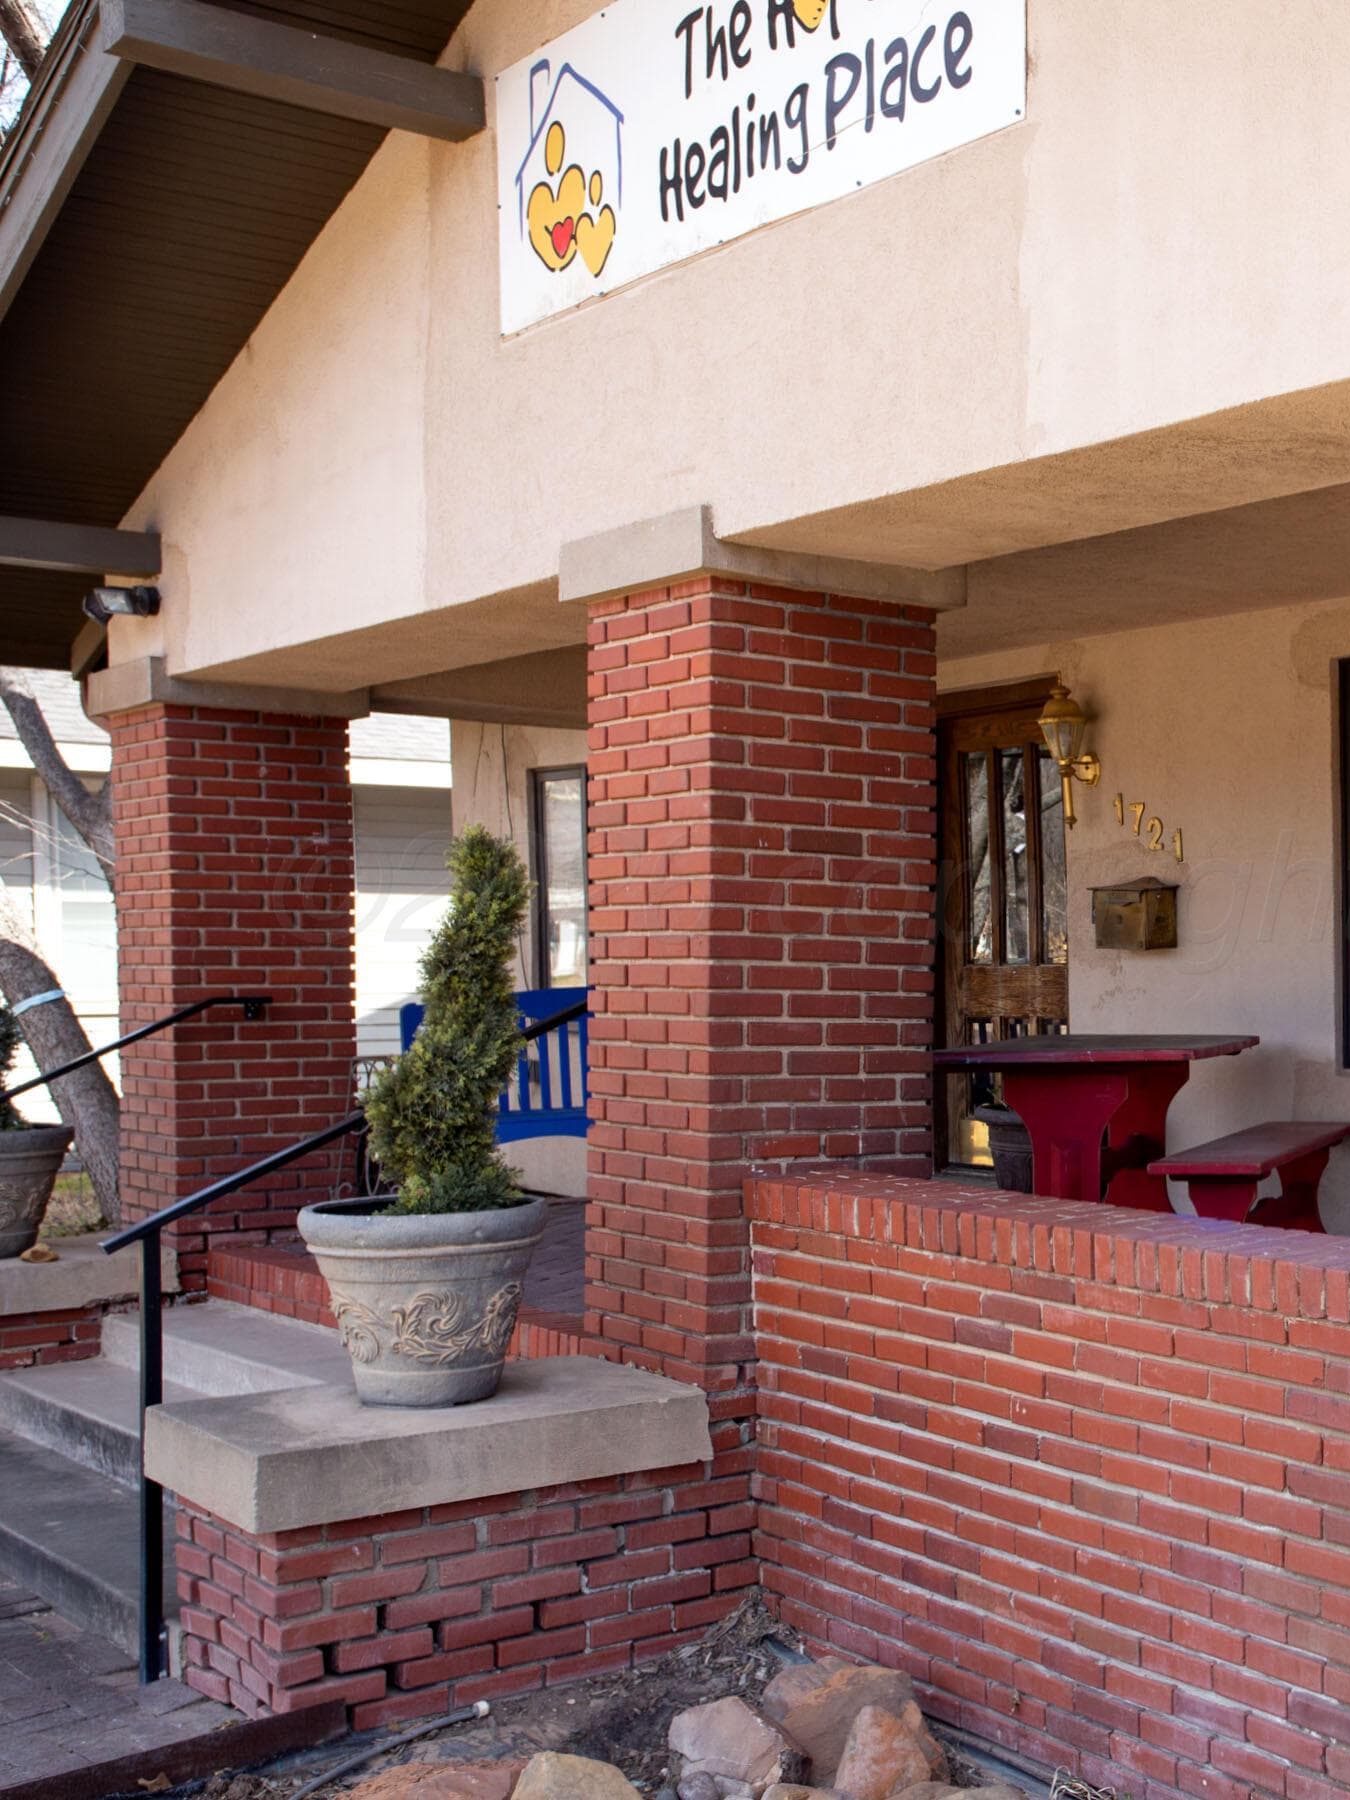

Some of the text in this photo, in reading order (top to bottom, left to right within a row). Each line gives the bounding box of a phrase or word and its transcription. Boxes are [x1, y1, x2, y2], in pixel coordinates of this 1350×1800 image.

[675, 0, 752, 99] The
[660, 11, 973, 222] Healing Place
[1113, 792, 1184, 863] 1721
